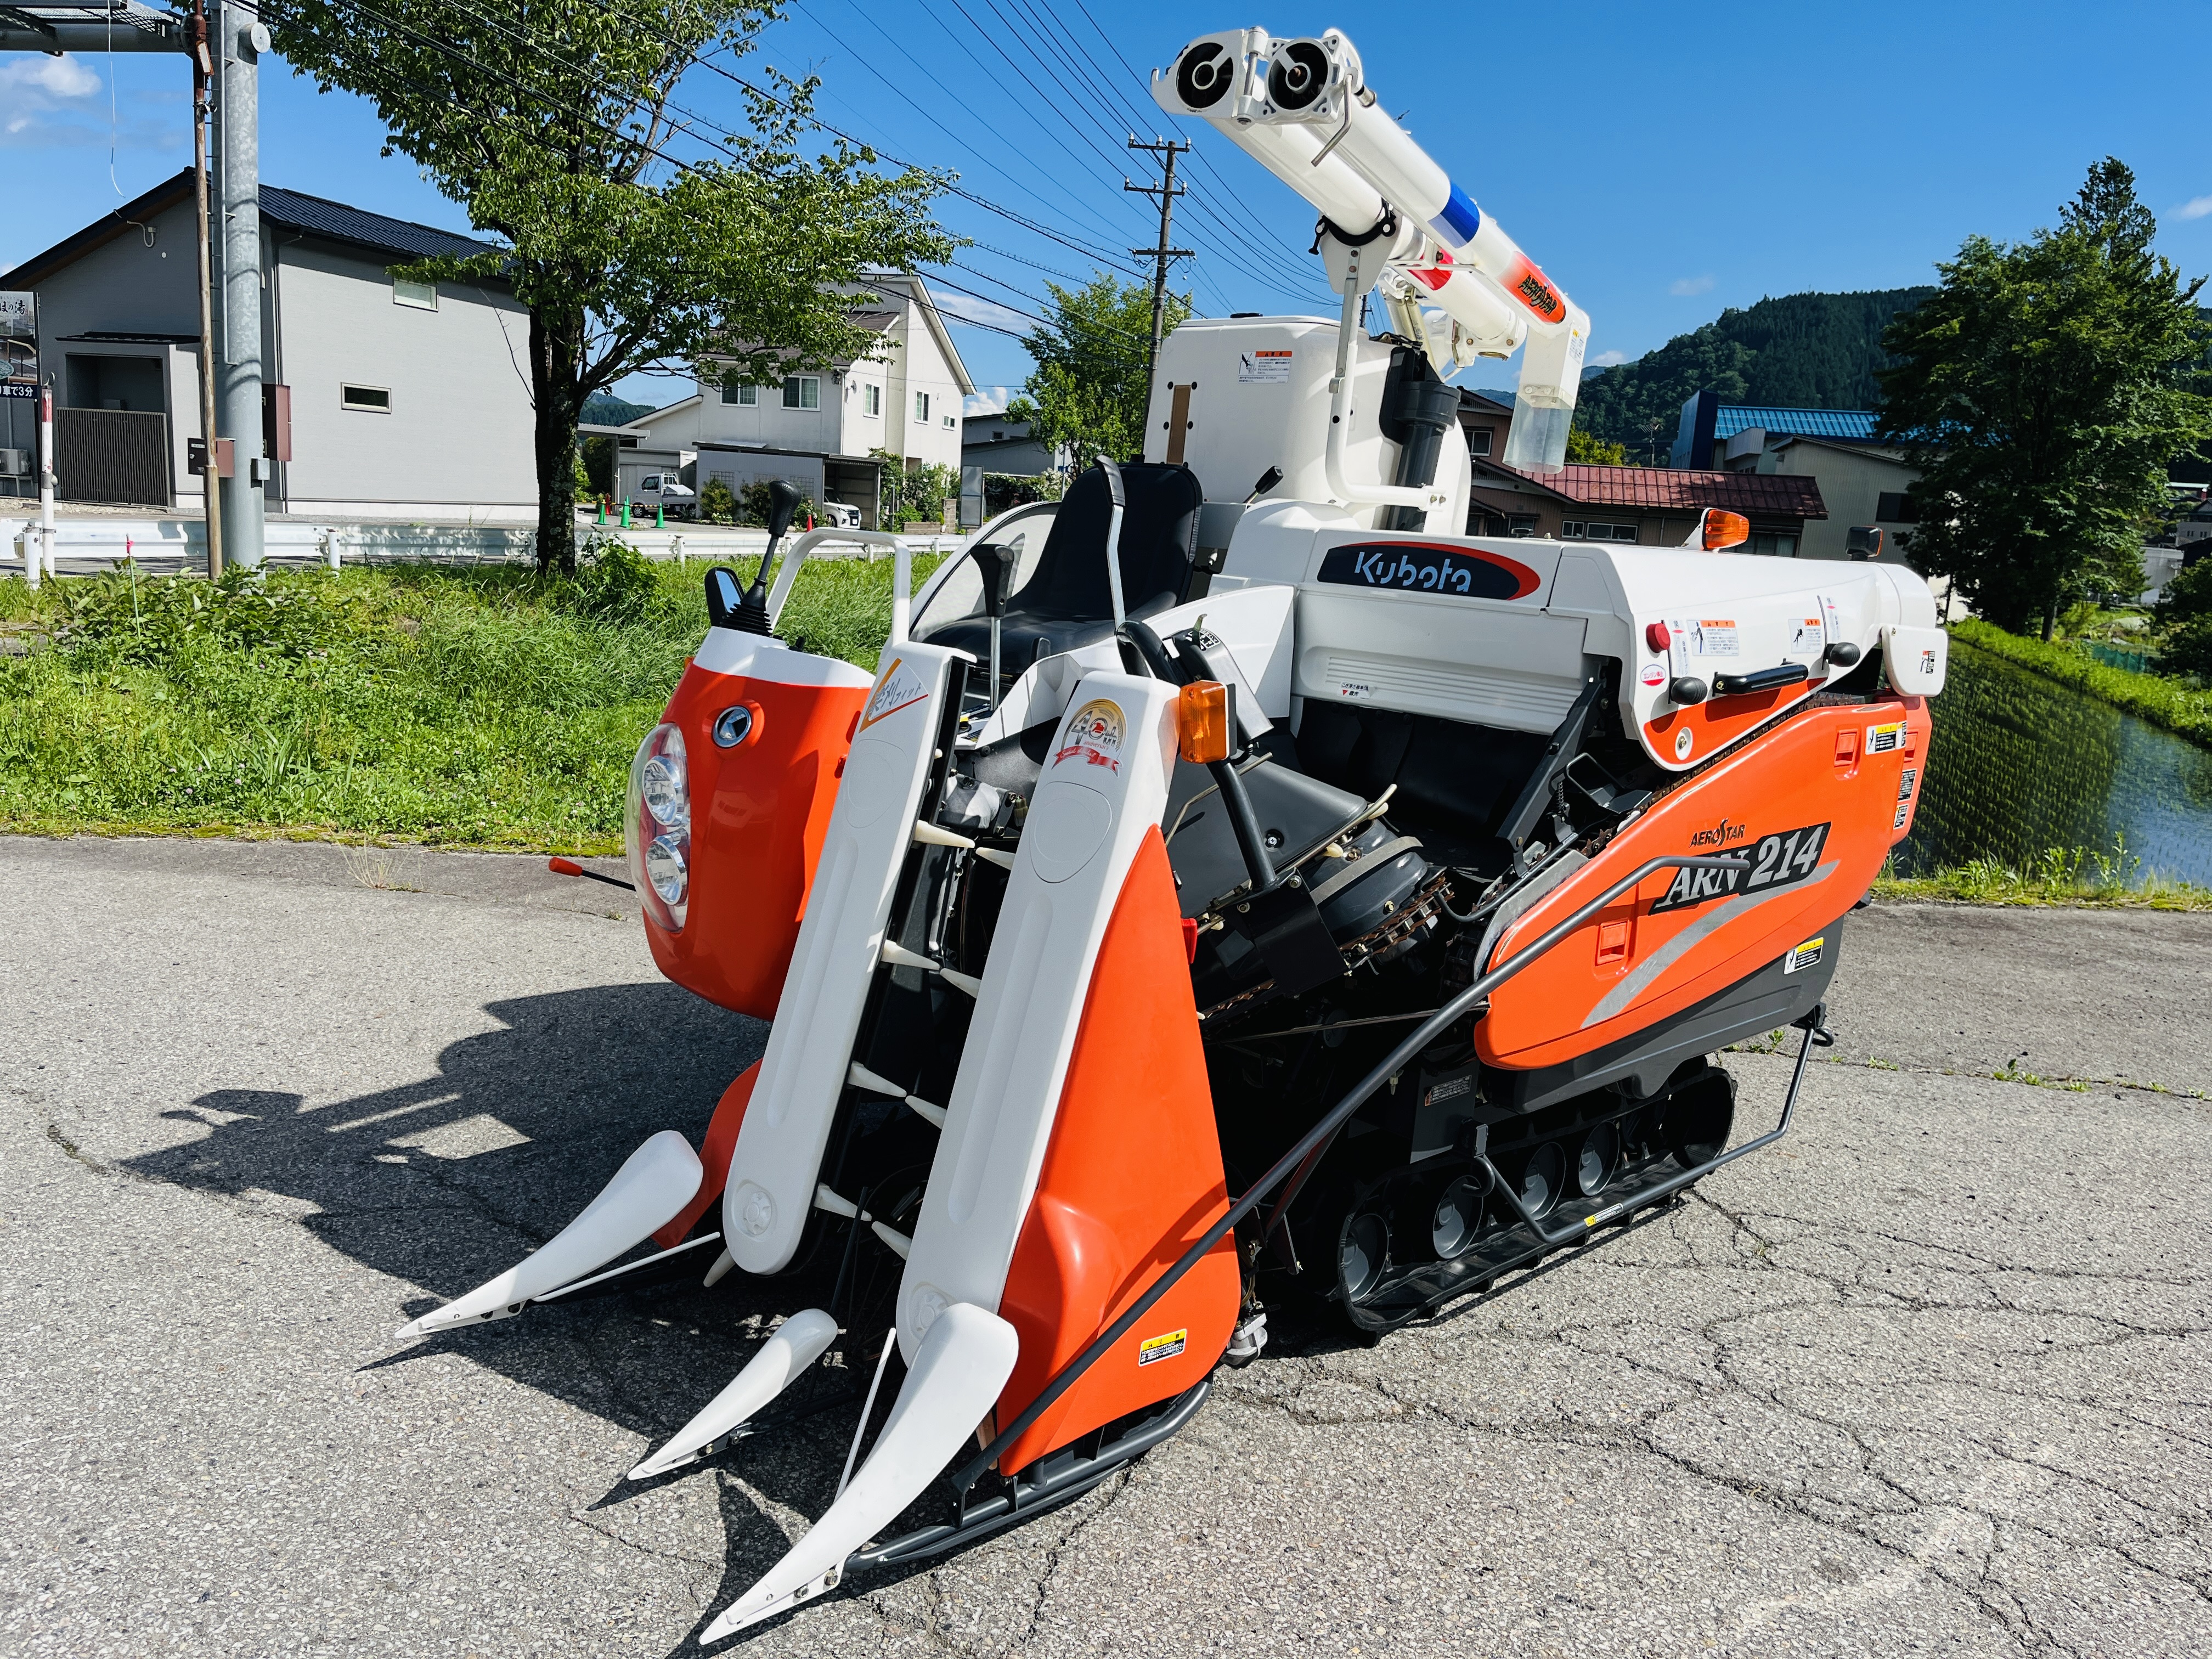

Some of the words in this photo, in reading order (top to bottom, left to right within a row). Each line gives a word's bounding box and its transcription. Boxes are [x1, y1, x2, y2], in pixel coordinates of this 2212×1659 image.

[1355, 551, 1471, 592] Kubota
[1071, 710, 1117, 747] 40th
[1747, 826, 1824, 889] 214
